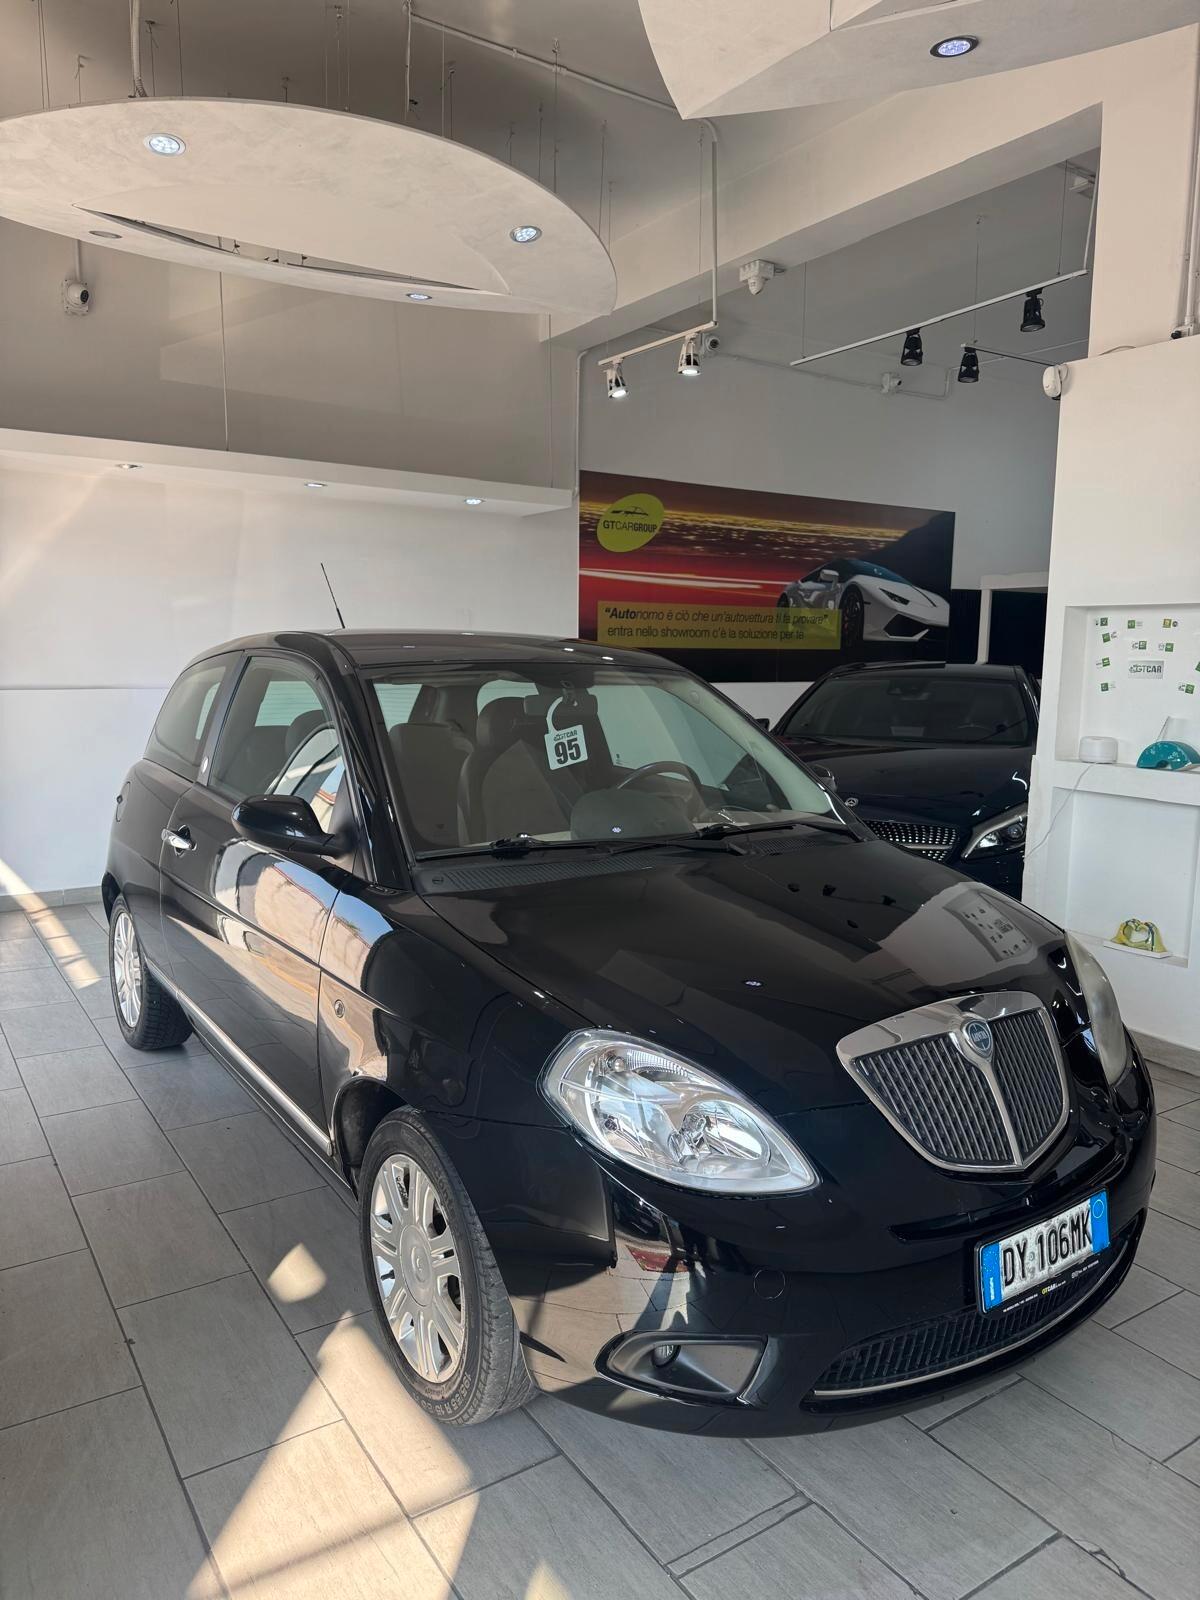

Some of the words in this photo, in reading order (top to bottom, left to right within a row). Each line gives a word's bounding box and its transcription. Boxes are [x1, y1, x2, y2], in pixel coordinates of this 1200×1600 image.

[603, 519, 657, 533] GTCARGROUP
[691, 610, 709, 621] che
[608, 627, 633, 637] entra
[636, 626, 658, 637] nello
[661, 627, 710, 638] showroom
[728, 629, 736, 639] la
[738, 629, 778, 640] soluzione
[780, 631, 793, 641] per
[554, 738, 581, 765] 95
[1003, 1239, 1028, 1287] DY
